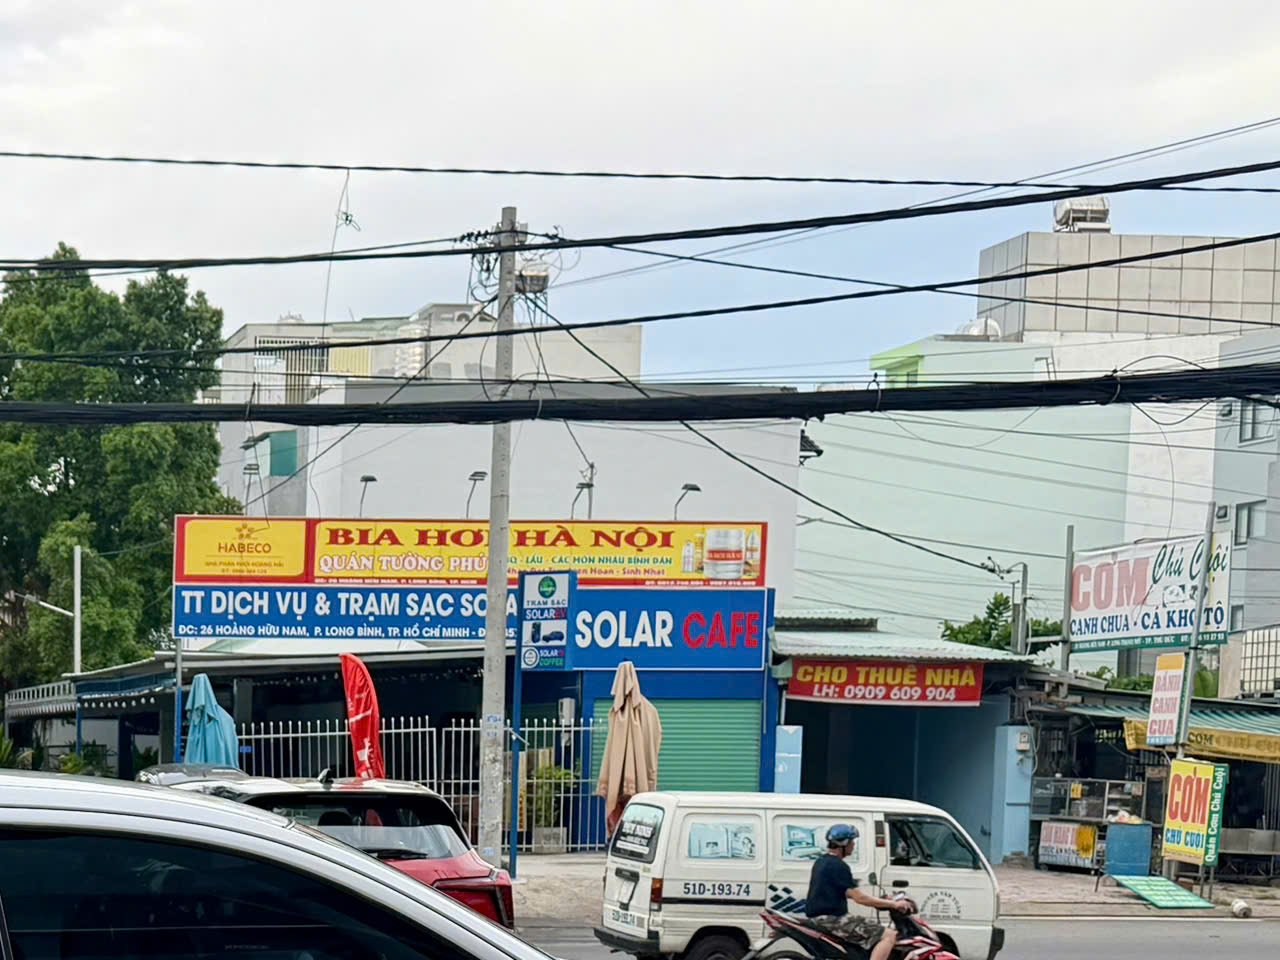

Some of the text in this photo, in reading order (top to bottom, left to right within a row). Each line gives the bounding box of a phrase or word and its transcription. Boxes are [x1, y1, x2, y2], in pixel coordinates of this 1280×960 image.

[218, 542, 272, 553] HABECO
[326, 525, 675, 552] BIA HƠ HÀ NỘI
[319, 551, 373, 572] QUÁN
[378, 551, 443, 572] TƯỜNG
[1071, 556, 1150, 612] CƠM
[181, 590, 205, 614] TT
[210, 590, 269, 620] DỊCH
[275, 591, 307, 621] VỤ
[314, 592, 331, 616] &
[337, 592, 400, 621] TRẠM
[406, 592, 455, 622] SẠC
[1070, 617, 1098, 636] CANH
[1100, 614, 1130, 633] CHUA
[1141, 606, 1161, 630] CÁ
[1203, 600, 1225, 630] TỘ
[178, 624, 198, 635] ĐC:
[200, 624, 214, 635] 26
[215, 621, 255, 635] HOÀNG
[258, 622, 280, 636] HỮU
[282, 625, 310, 637] NAM,
[314, 625, 322, 636] P.
[325, 626, 355, 637] LONG
[357, 623, 385, 638] BÌNH,
[387, 626, 400, 637] TP.
[403, 622, 420, 637] HỒ
[422, 624, 440, 637] CHÍ
[442, 626, 469, 637] MINH
[575, 610, 760, 649] SOLAR CAFE
[796, 664, 976, 686] CHO THUÊ NHÀ
[813, 684, 956, 701] LH: 0909 609 904
[1149, 719, 1174, 735] CUA
[1168, 766, 1210, 825] CƠM
[1210, 792, 1222, 812] Chú
[1208, 813, 1219, 836] Cơm
[1205, 836, 1217, 862] Quán
[683, 882, 751, 897] 51D-193.74
